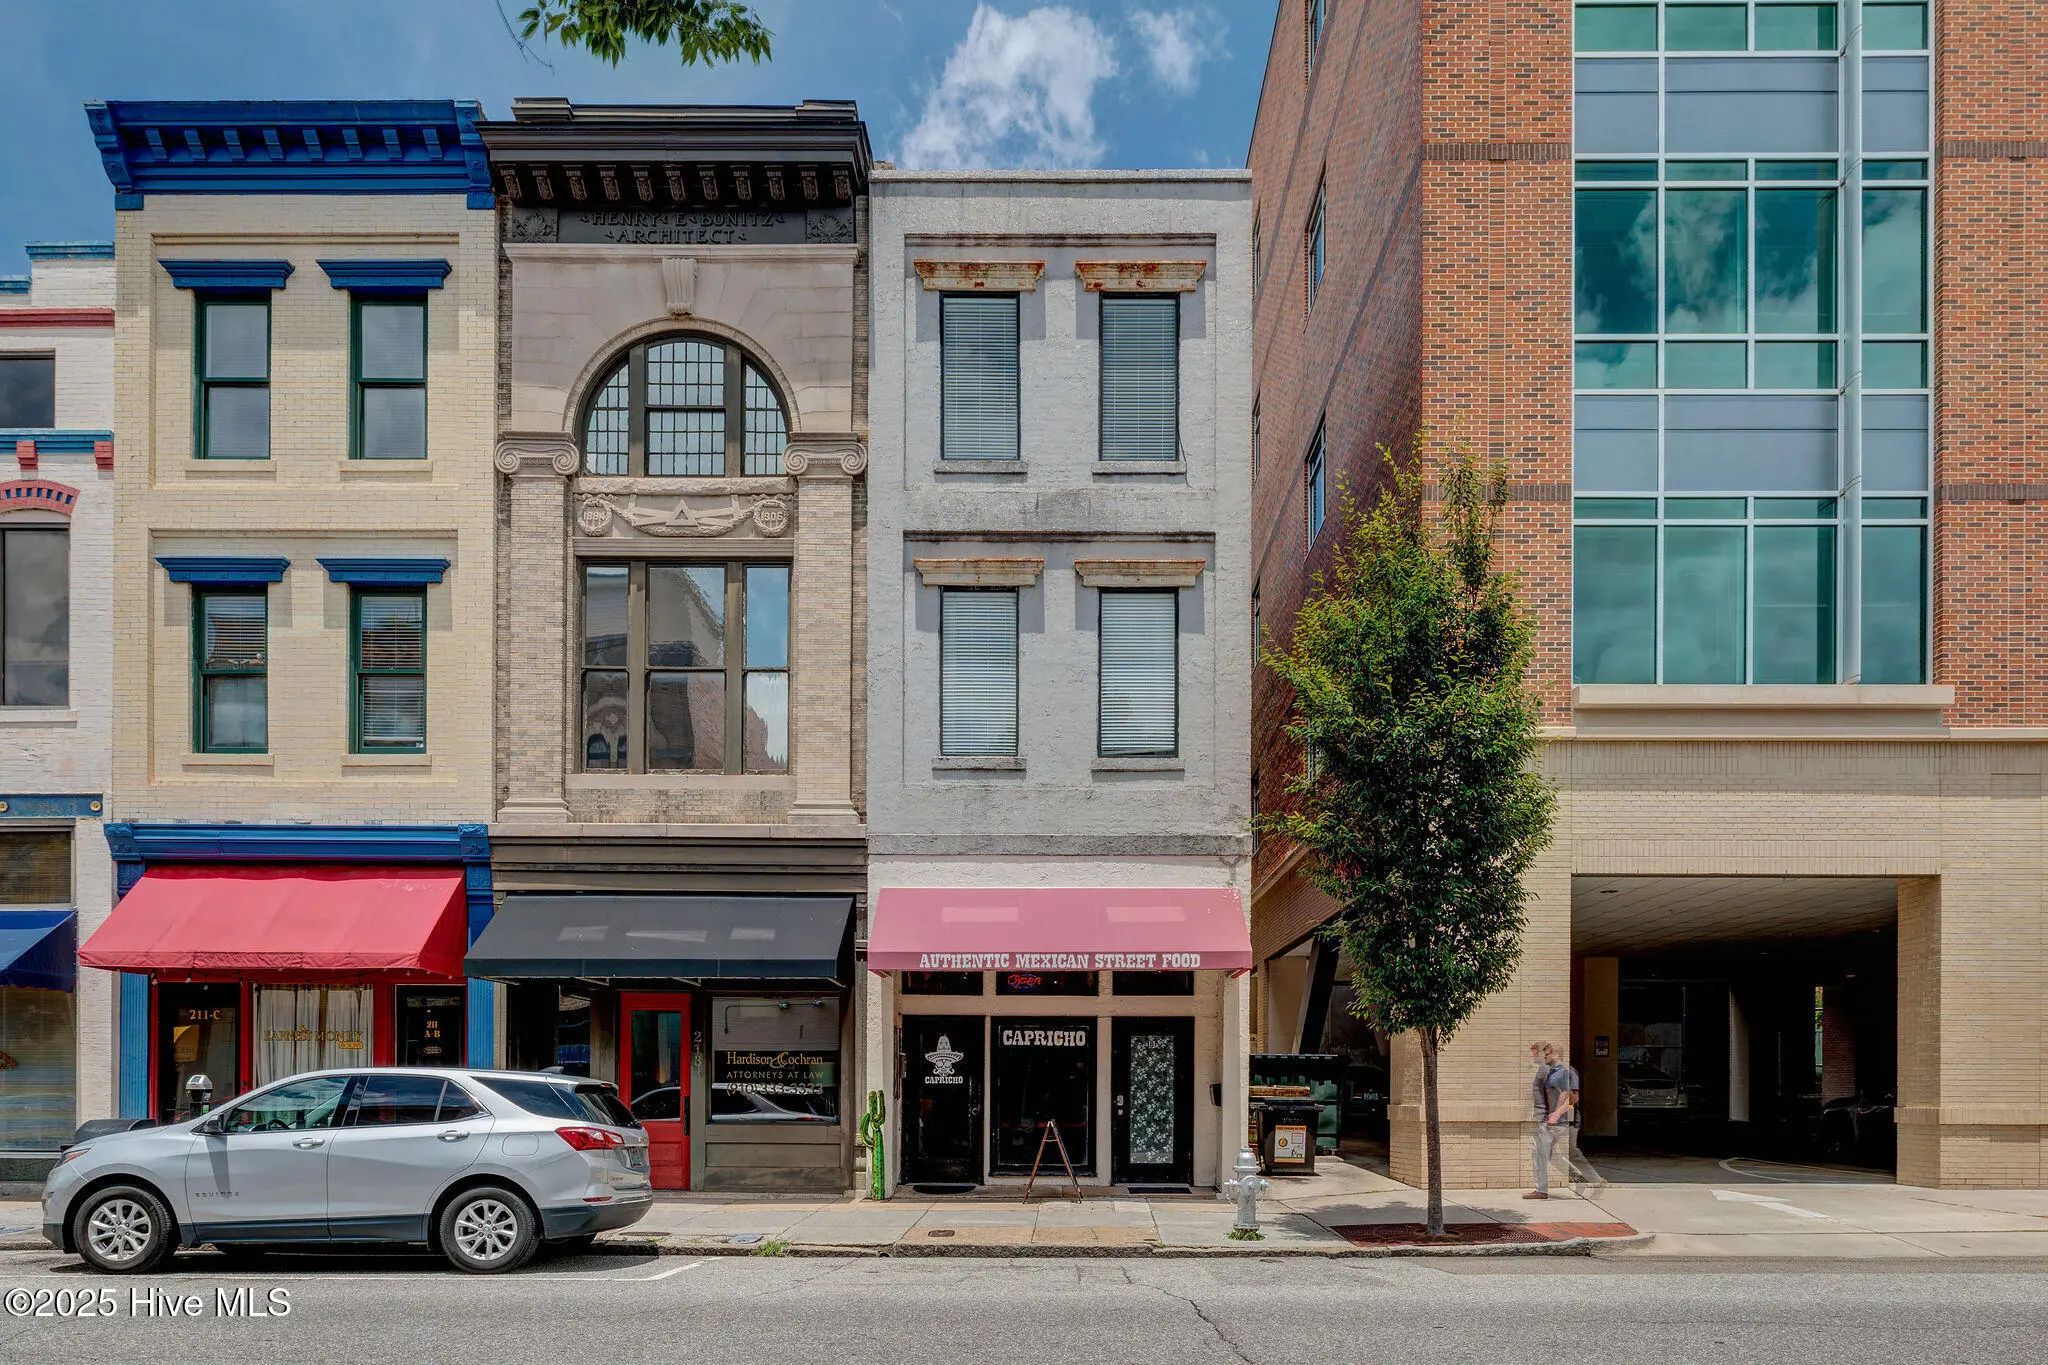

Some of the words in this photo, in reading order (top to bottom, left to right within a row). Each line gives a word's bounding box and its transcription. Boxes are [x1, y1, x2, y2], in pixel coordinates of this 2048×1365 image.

[592, 212, 660, 226] HENRY
[675, 213, 688, 226] E
[700, 212, 774, 226] BONITZ
[617, 230, 735, 244] ARCHITECT
[759, 510, 783, 521] 1906
[919, 953, 1010, 969] AUTHENTIC
[1015, 953, 1089, 969] MEXICAN
[1095, 953, 1157, 969] STREET
[1162, 953, 1201, 968] FOOD
[189, 1009, 221, 1020] 211-C
[426, 1020, 438, 1029] 211
[1003, 1030, 1086, 1046] CAPRICHO
[727, 1051, 772, 1065] Hardison
[779, 1051, 823, 1065] Cochran
[727, 1071, 783, 1079] ATTORNEYS
[787, 1071, 799, 1079] AT
[803, 1071, 824, 1079] LAW
[925, 1076, 964, 1084] CAPRICHO
